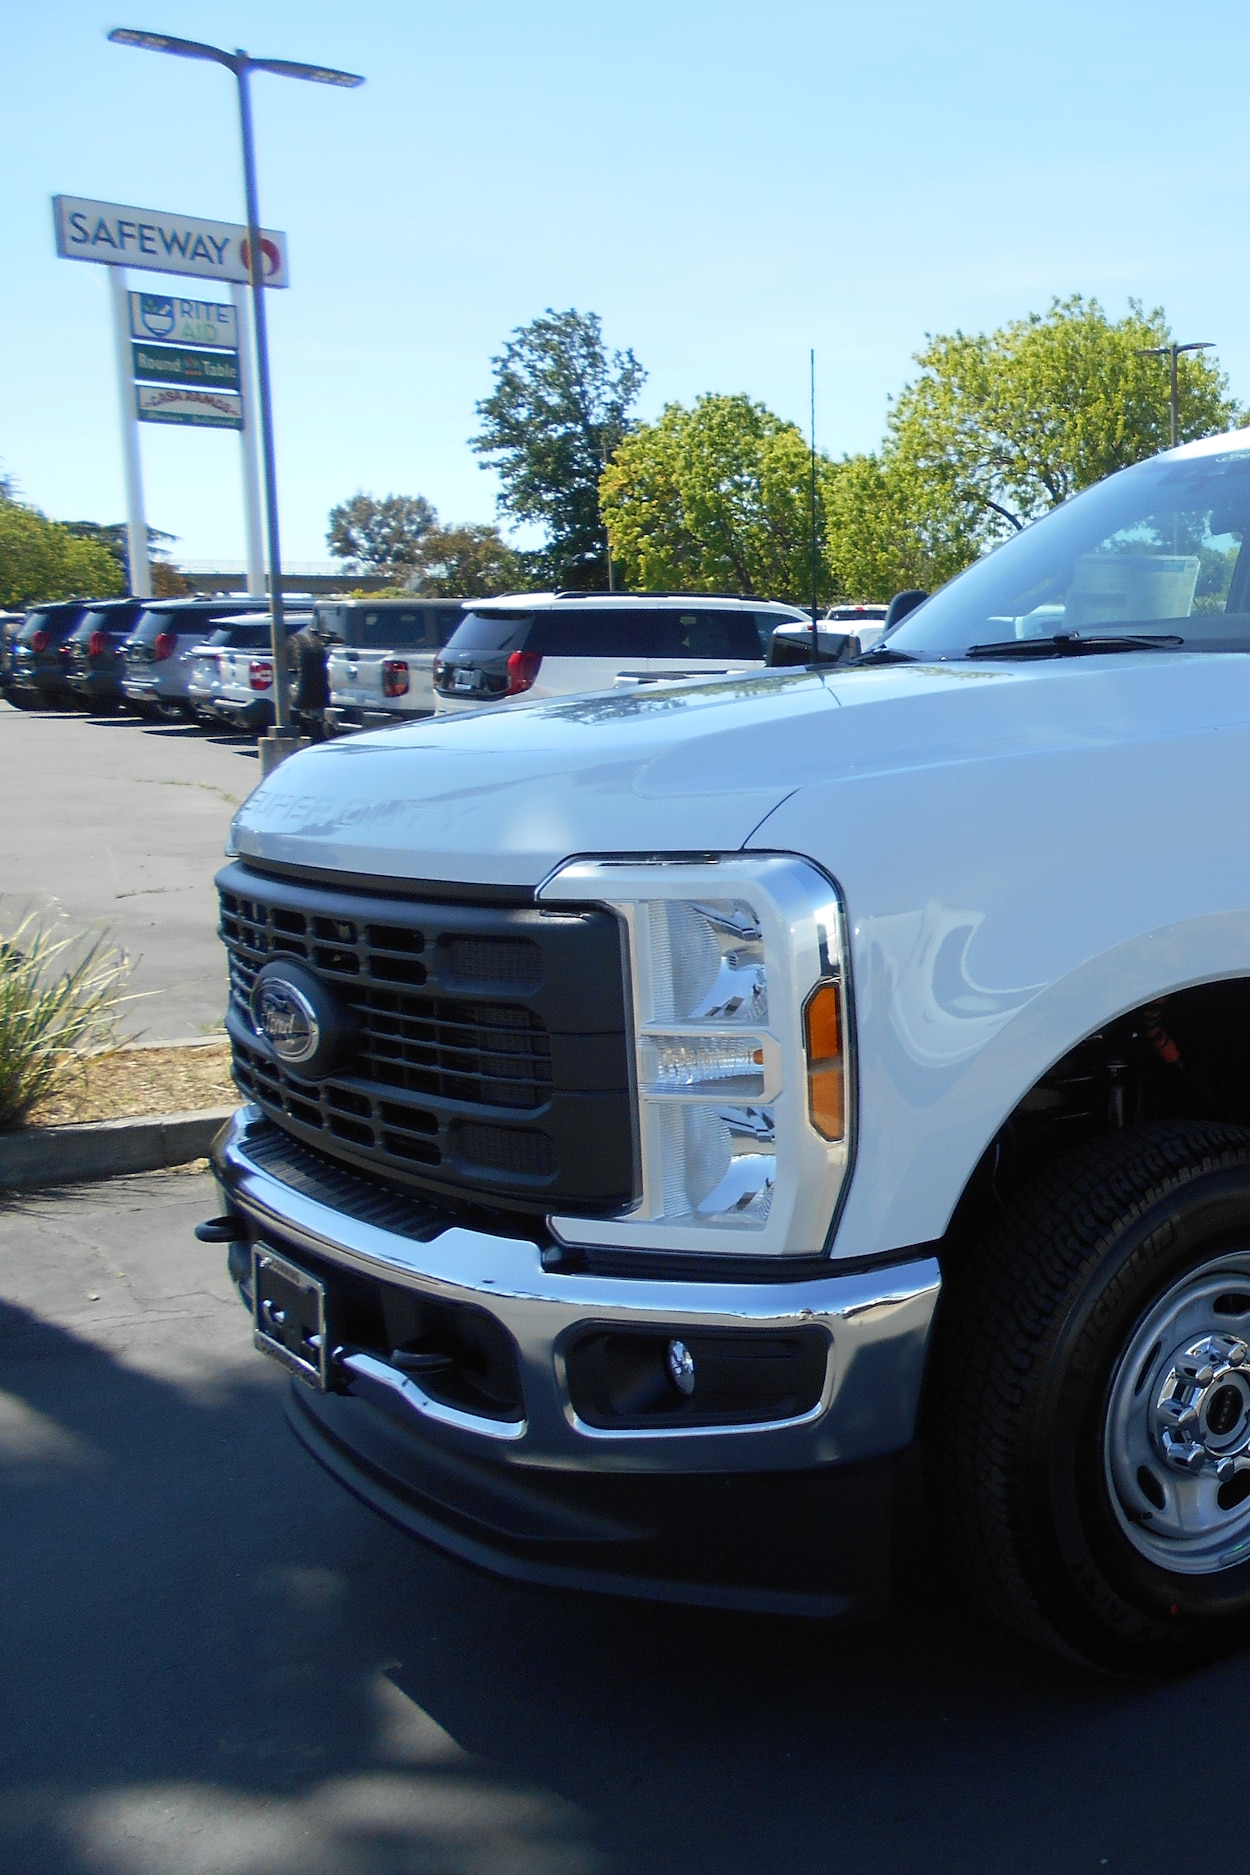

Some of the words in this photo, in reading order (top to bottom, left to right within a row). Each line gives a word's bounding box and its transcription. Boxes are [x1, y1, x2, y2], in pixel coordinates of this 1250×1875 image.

[69, 211, 230, 265] SAFEWAY
[180, 300, 229, 323] RITE
[181, 320, 218, 342] AID
[138, 352, 181, 373] Round
[202, 360, 238, 379] Table
